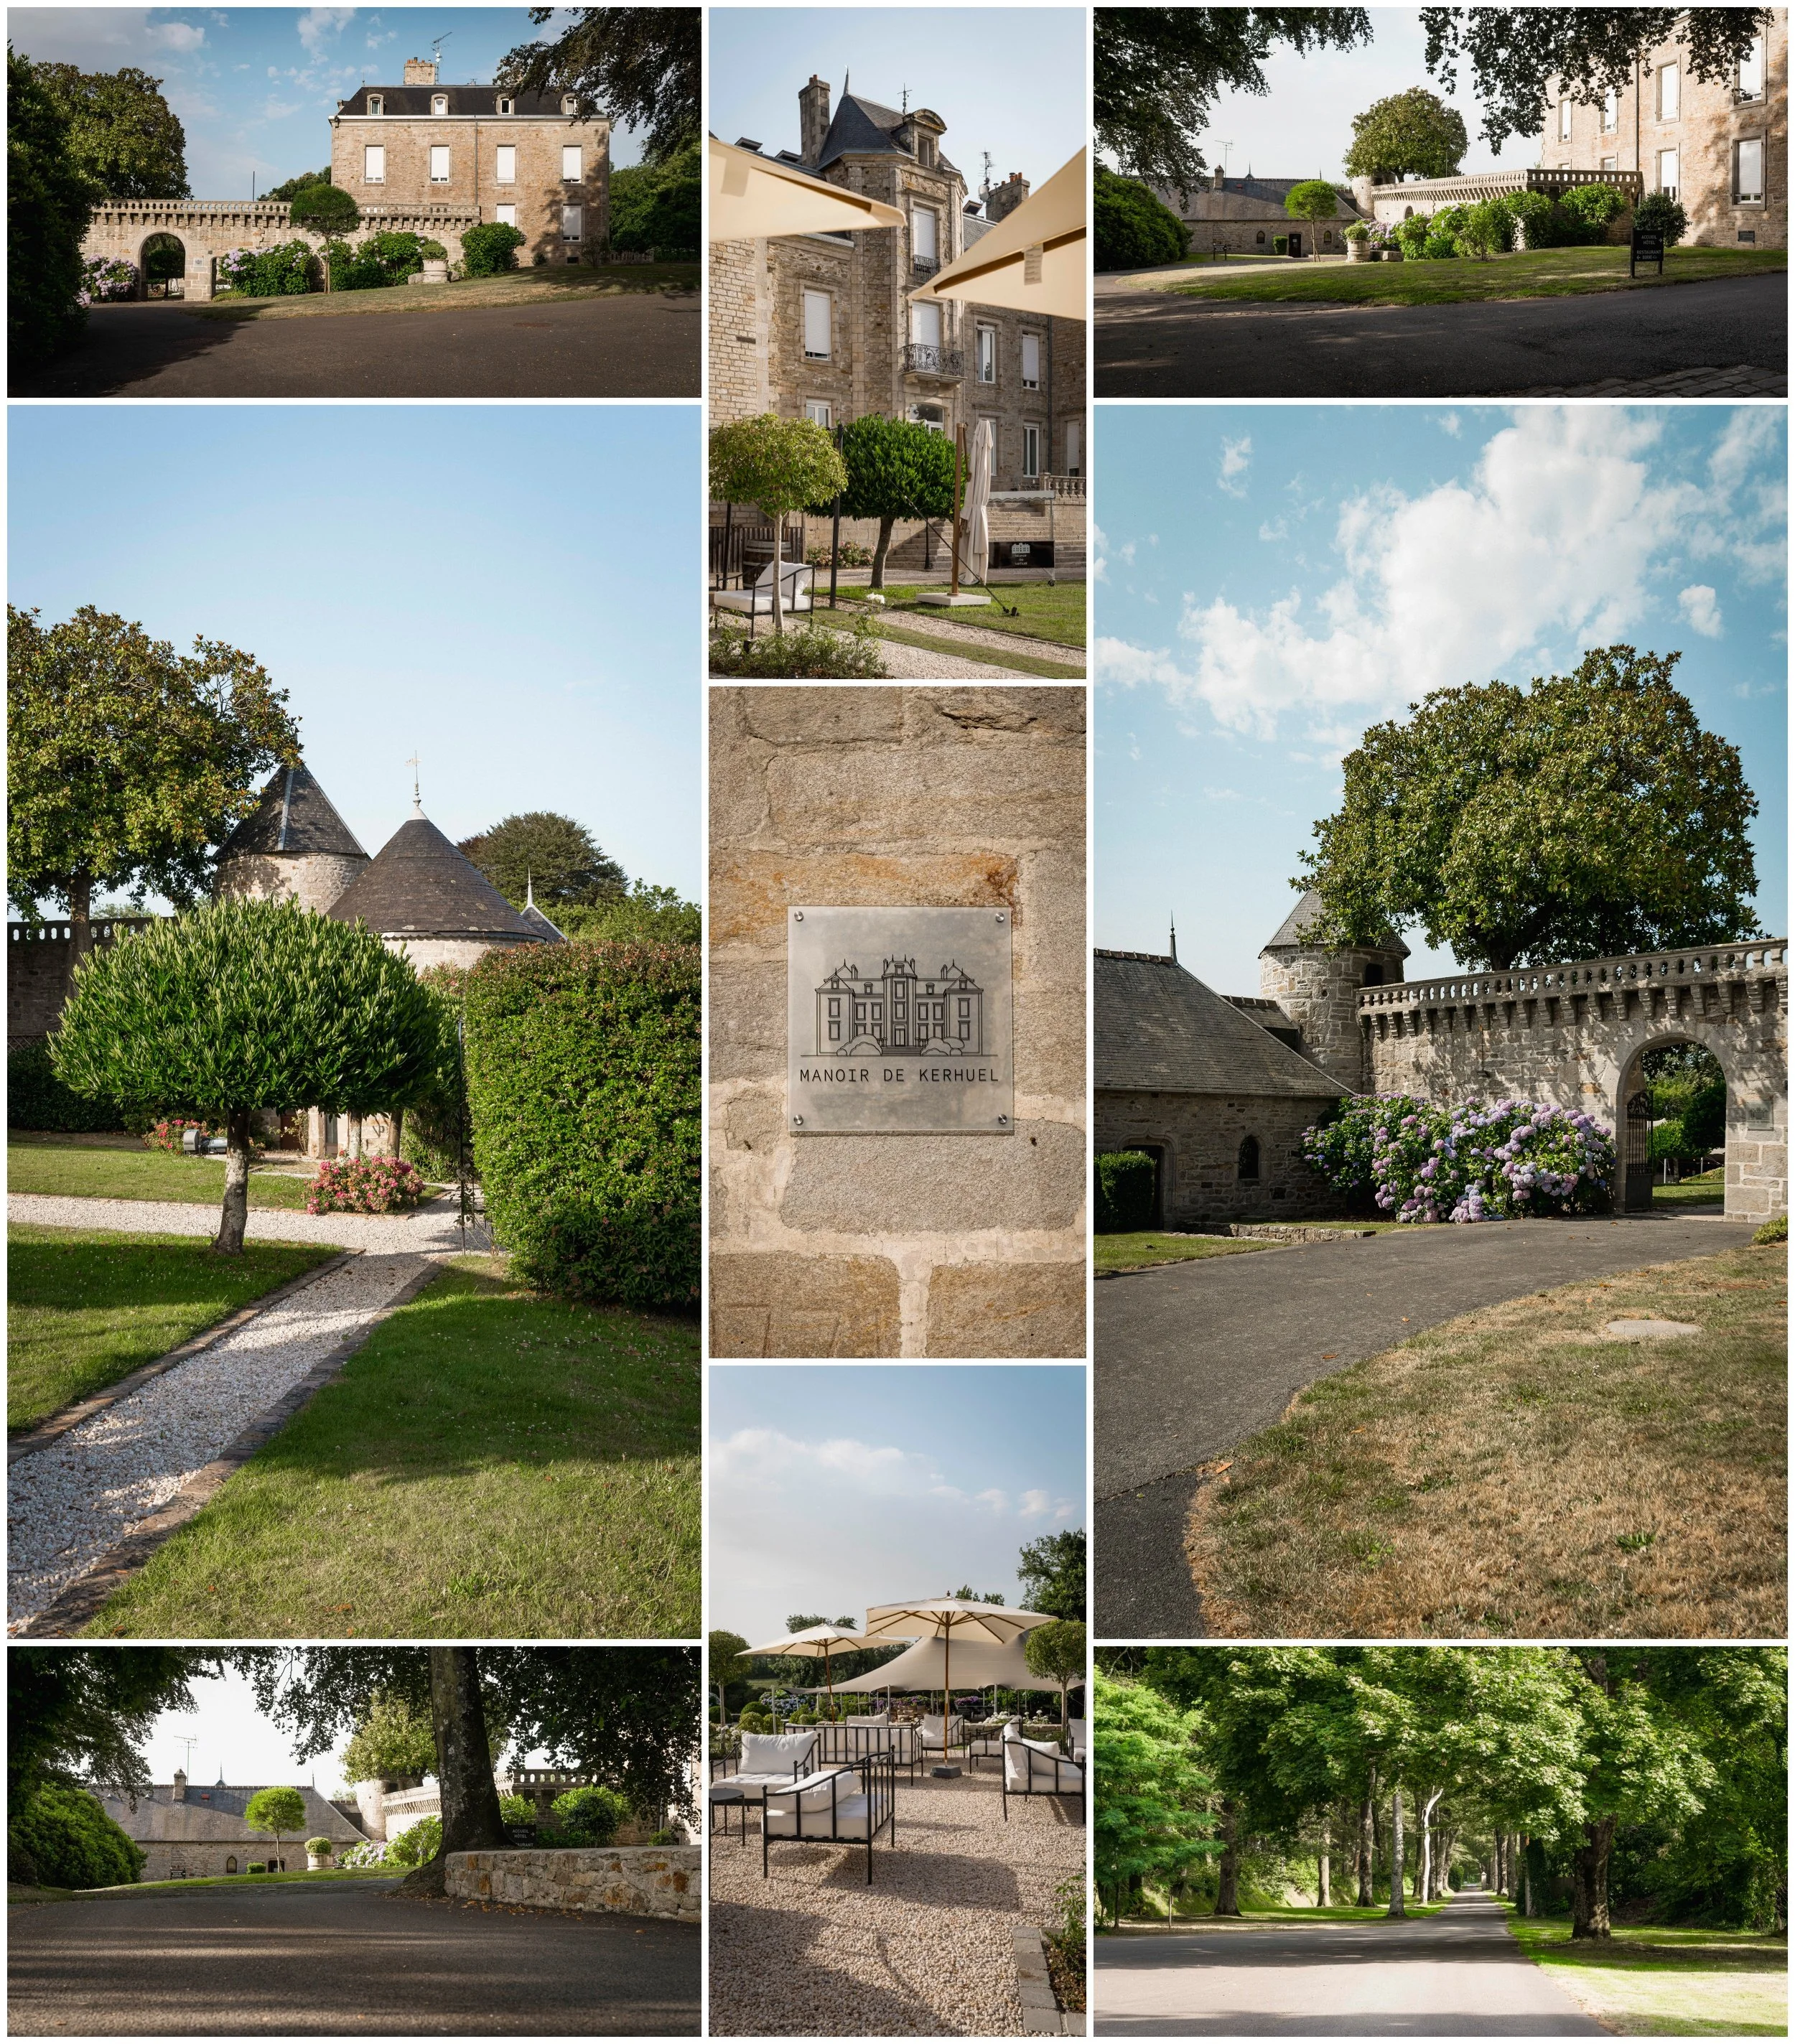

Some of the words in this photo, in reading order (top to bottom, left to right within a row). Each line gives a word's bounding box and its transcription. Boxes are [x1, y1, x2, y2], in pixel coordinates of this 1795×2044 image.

[799, 1068, 869, 1082] MANOIR
[883, 1068, 905, 1082] DE
[919, 1068, 999, 1082] KERHUEL
